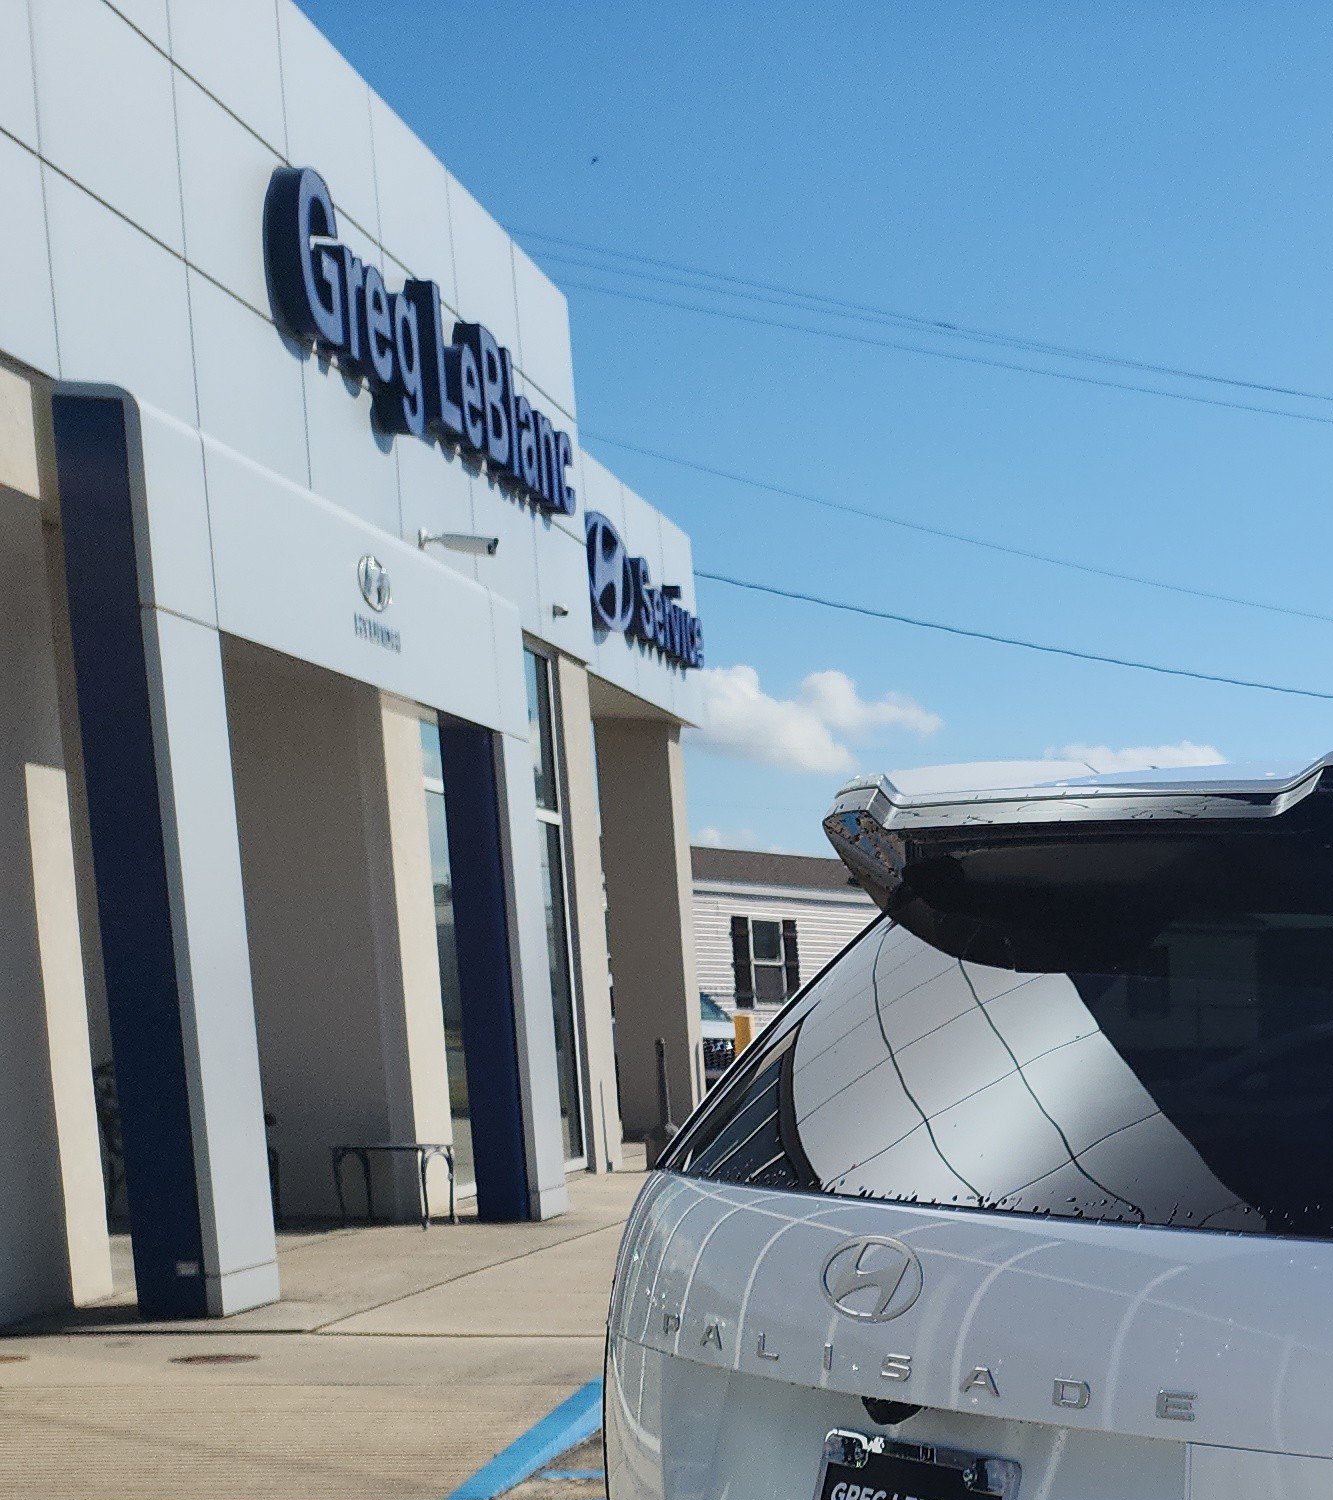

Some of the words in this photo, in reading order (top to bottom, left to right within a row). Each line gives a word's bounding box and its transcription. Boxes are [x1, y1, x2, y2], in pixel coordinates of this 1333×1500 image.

[264, 166, 427, 436] Greg
[405, 279, 576, 516] LeBlanc
[630, 557, 705, 669] Service
[662, 1312, 1198, 1422] PALISADE
